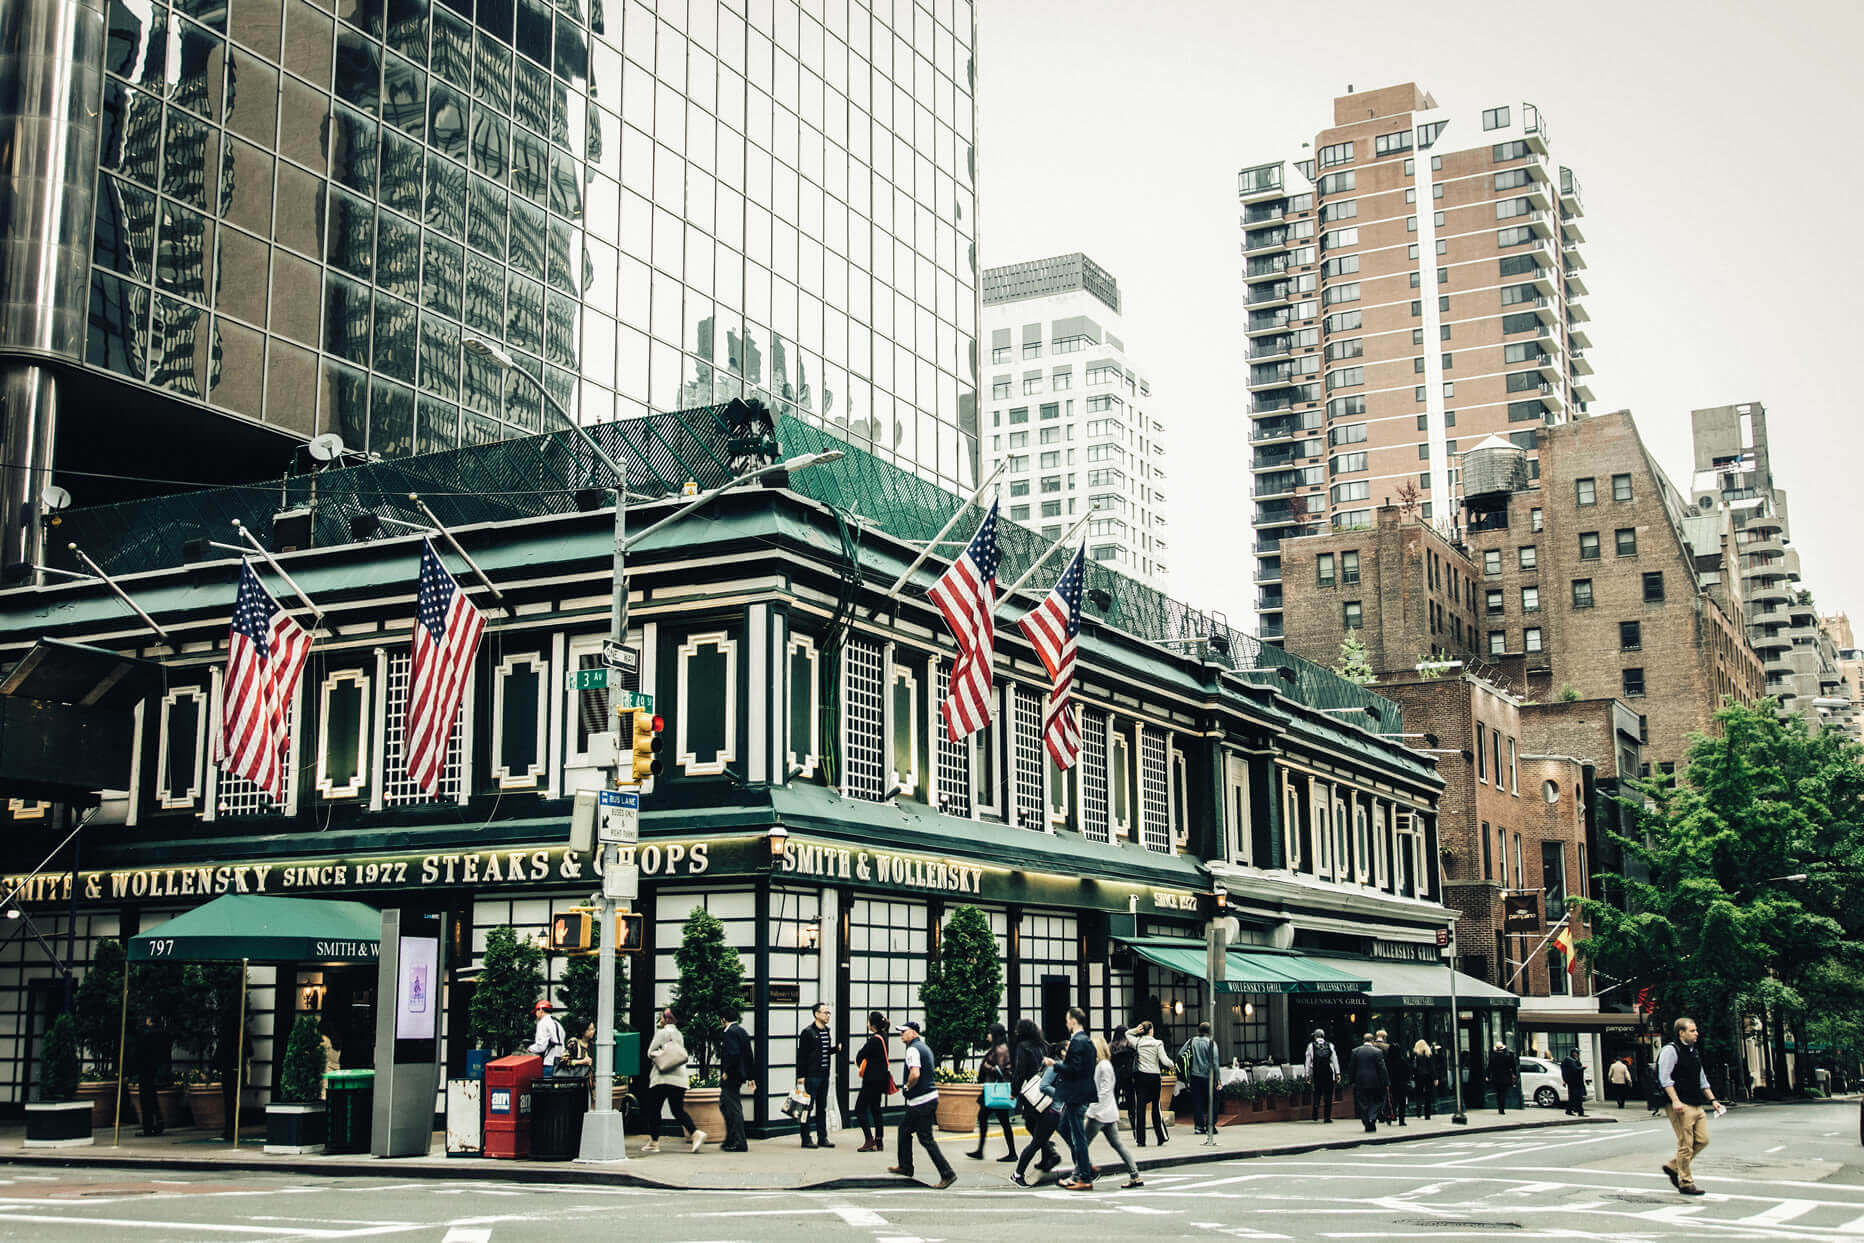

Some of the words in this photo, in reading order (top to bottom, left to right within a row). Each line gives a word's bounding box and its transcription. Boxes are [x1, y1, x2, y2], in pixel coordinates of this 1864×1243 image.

[623, 655, 634, 663] WAY
[583, 672, 589, 687] 3
[609, 795, 620, 804] BUS
[622, 796, 636, 806] LANE
[85, 873, 102, 899] &
[111, 865, 273, 898] WOLLENSKY
[282, 865, 348, 887] SINCE
[354, 862, 409, 884] 1977
[421, 851, 550, 884] STEAKS
[560, 850, 582, 879] &
[782, 841, 851, 879] SMITH
[856, 852, 871, 881] &
[875, 854, 983, 894] WOLLENSKY
[1154, 892, 1178, 909] SINCE
[1179, 895, 1198, 911] 1977
[149, 939, 175, 957] 797
[316, 941, 356, 957] SMITH
[357, 943, 368, 957] &
[1228, 982, 1266, 993] WOLLENSKY'S
[1266, 982, 1282, 993] GRILL
